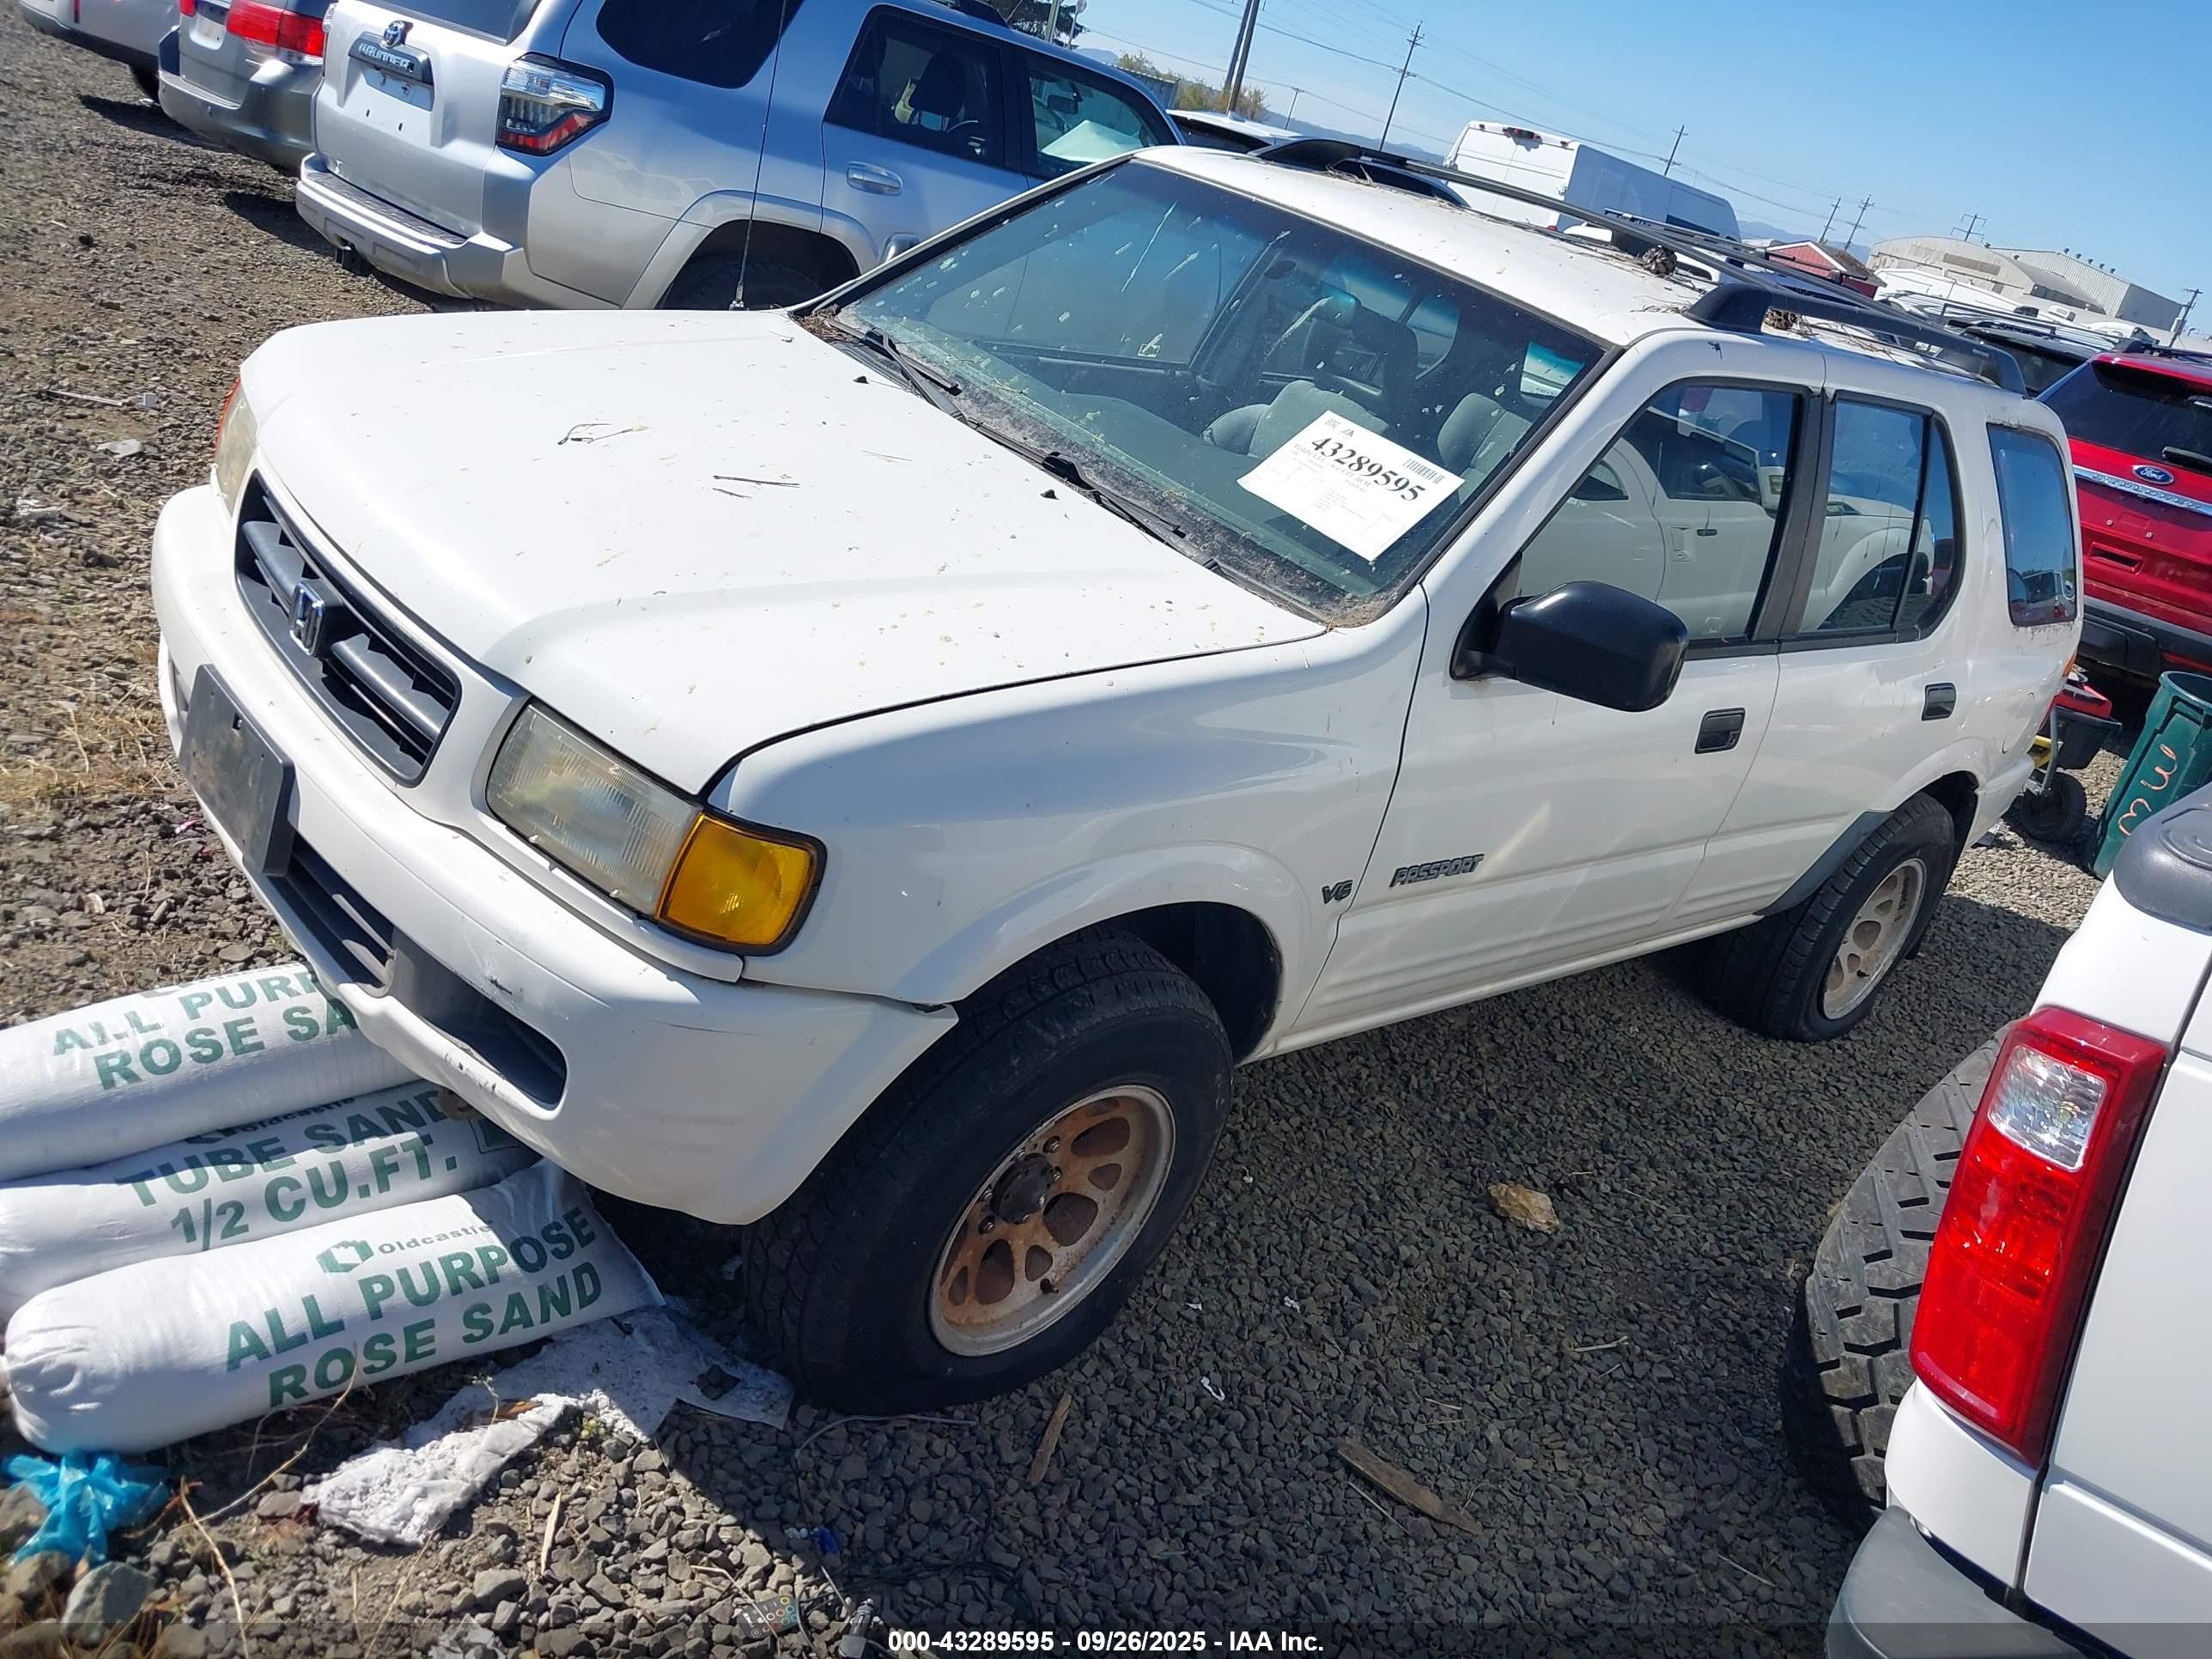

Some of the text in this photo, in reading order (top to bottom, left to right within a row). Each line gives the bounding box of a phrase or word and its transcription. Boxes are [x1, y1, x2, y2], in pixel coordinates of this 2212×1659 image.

[1311, 438, 1426, 501] 43289595
[2140, 467, 2165, 480] Ford
[1322, 879, 1353, 905] V6
[1389, 854, 1485, 888] PASSPORT
[53, 1011, 162, 1055] ALL
[93, 1016, 265, 1090] ROSE
[115, 1136, 297, 1208] TUBE
[170, 1133, 458, 1252] 1/2 CU.FT.
[378, 1223, 494, 1255] Oldcastle
[226, 1207, 597, 1372] ALL PURPOSE
[269, 1261, 601, 1408] ROSE SAND
